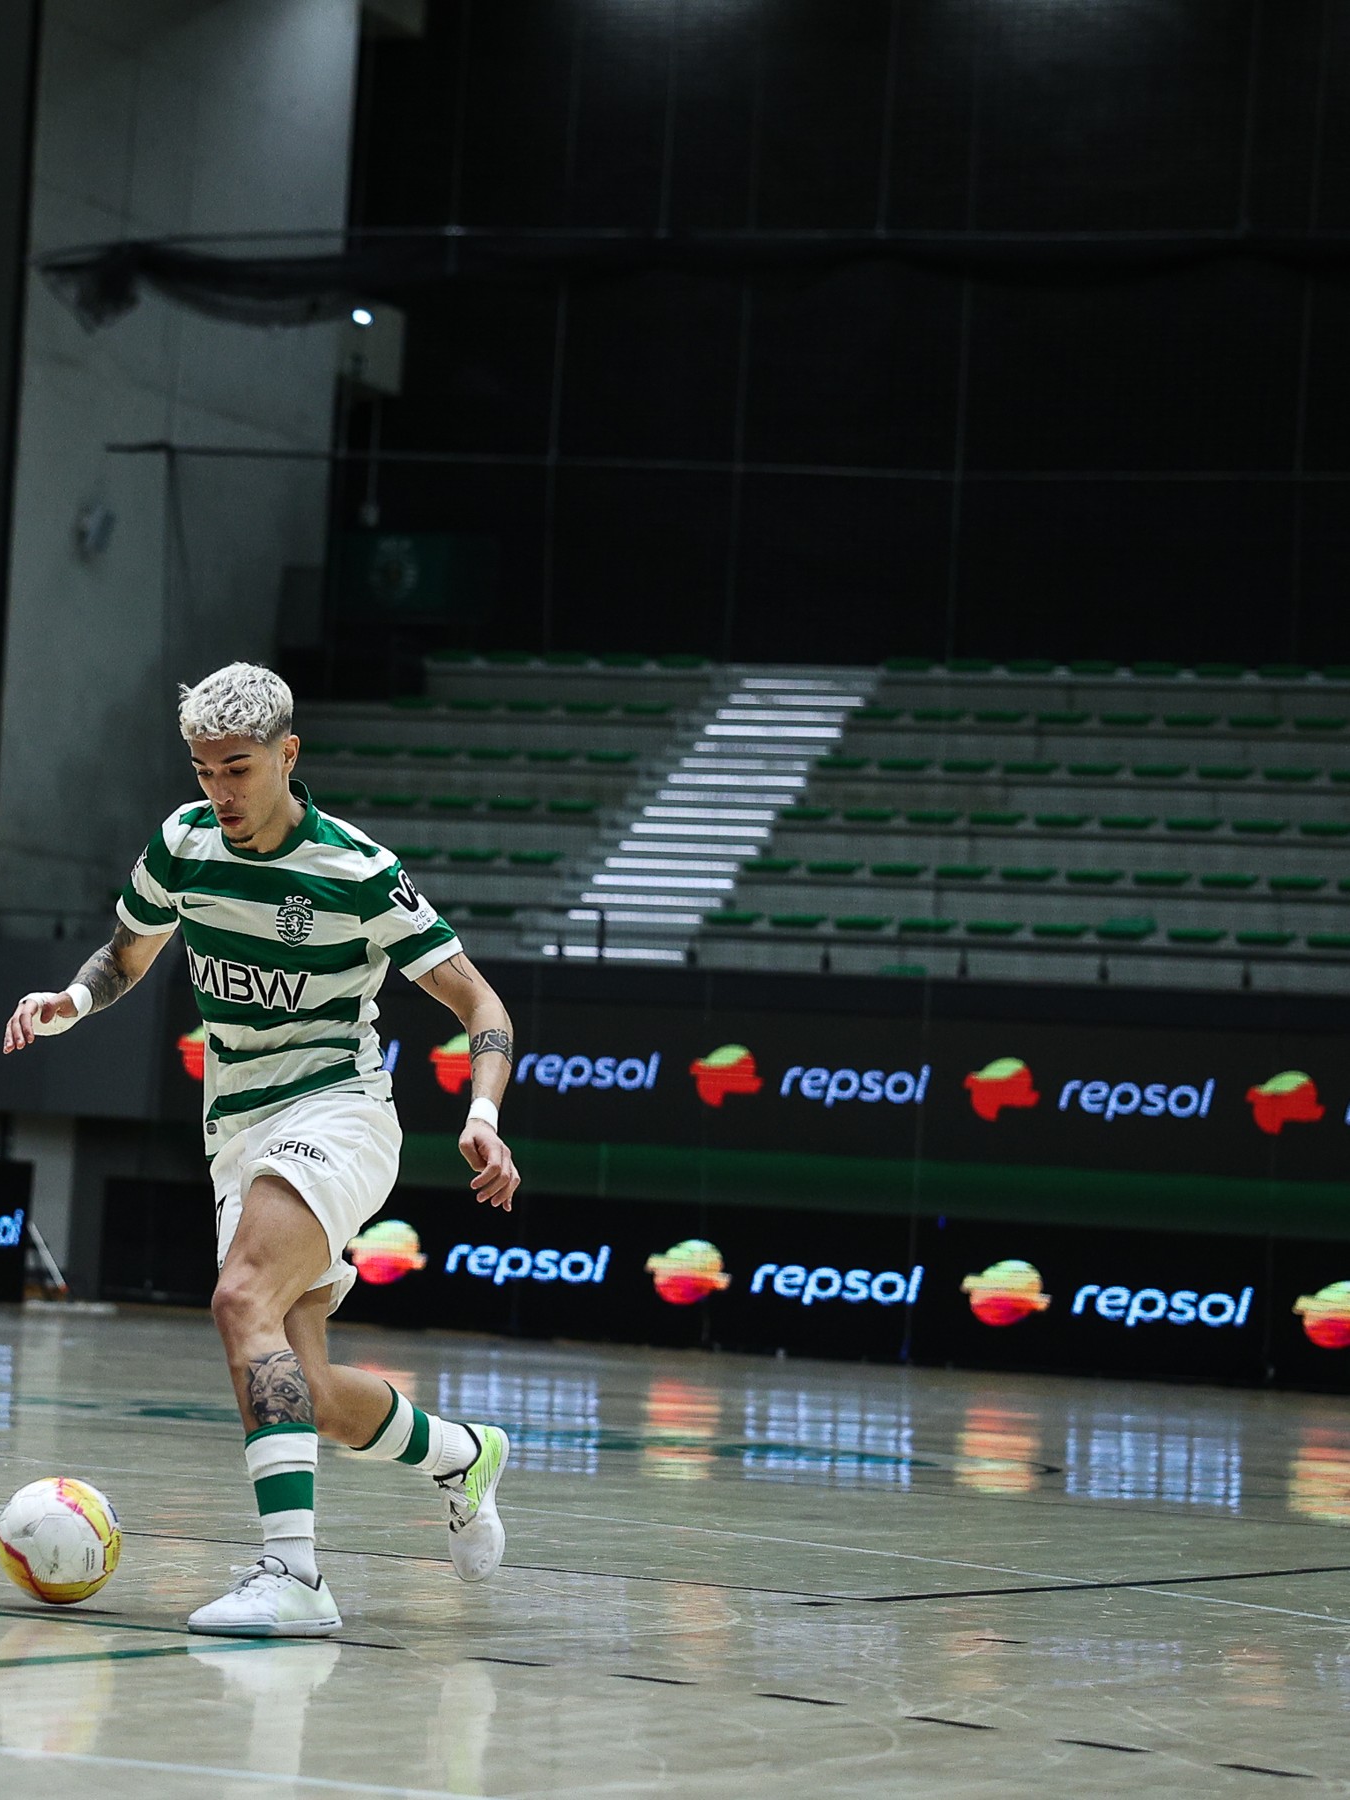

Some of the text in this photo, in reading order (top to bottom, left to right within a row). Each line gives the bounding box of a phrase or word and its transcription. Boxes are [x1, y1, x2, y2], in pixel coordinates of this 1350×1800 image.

[284, 895, 312, 906] SCP
[187, 945, 311, 1013] MBW
[515, 1050, 661, 1095] repsol
[779, 1064, 931, 1109] repsol
[1058, 1078, 1216, 1122] repsol
[446, 1244, 611, 1285] repsol
[751, 1263, 925, 1306] repsol
[1071, 1284, 1254, 1328] repsol
